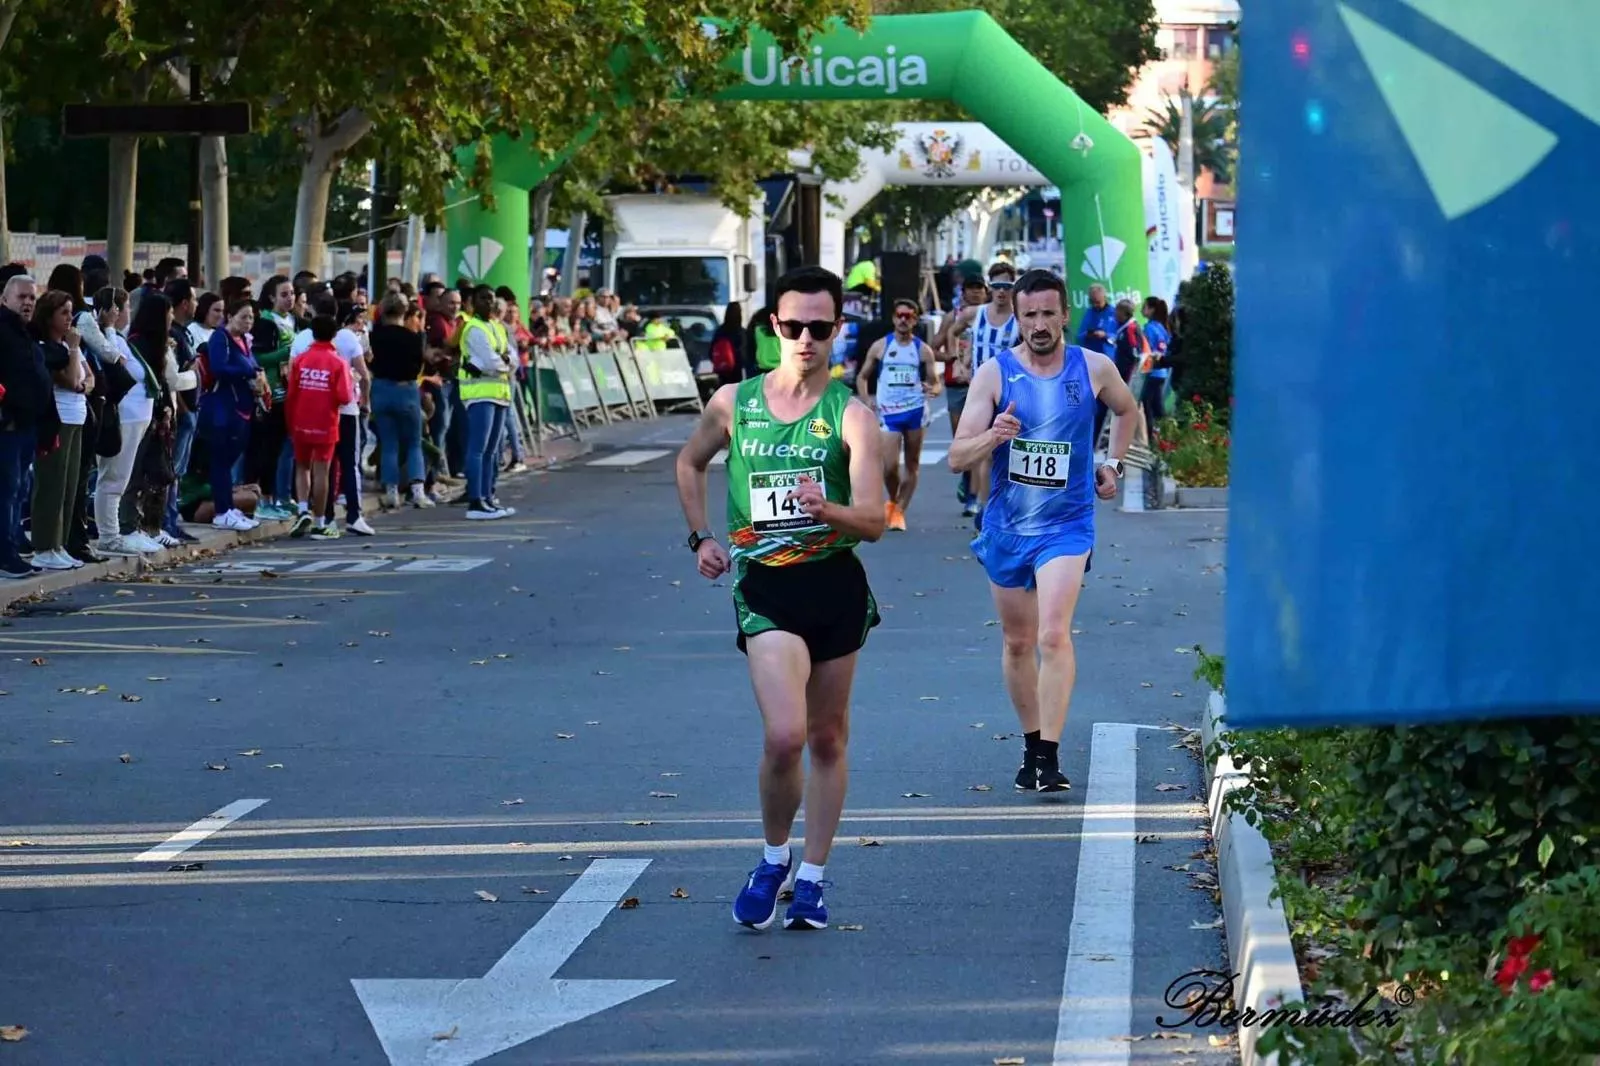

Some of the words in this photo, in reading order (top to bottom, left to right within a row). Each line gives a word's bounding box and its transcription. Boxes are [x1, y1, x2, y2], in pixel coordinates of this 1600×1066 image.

[742, 44, 928, 94] Unicaja
[300, 367, 331, 381] ZGZ
[741, 438, 828, 462] Huesca
[1026, 446, 1065, 454] TOLEDO
[1022, 454, 1056, 477] 118
[770, 475, 818, 487] TOLEO
[767, 490, 806, 517] 14
